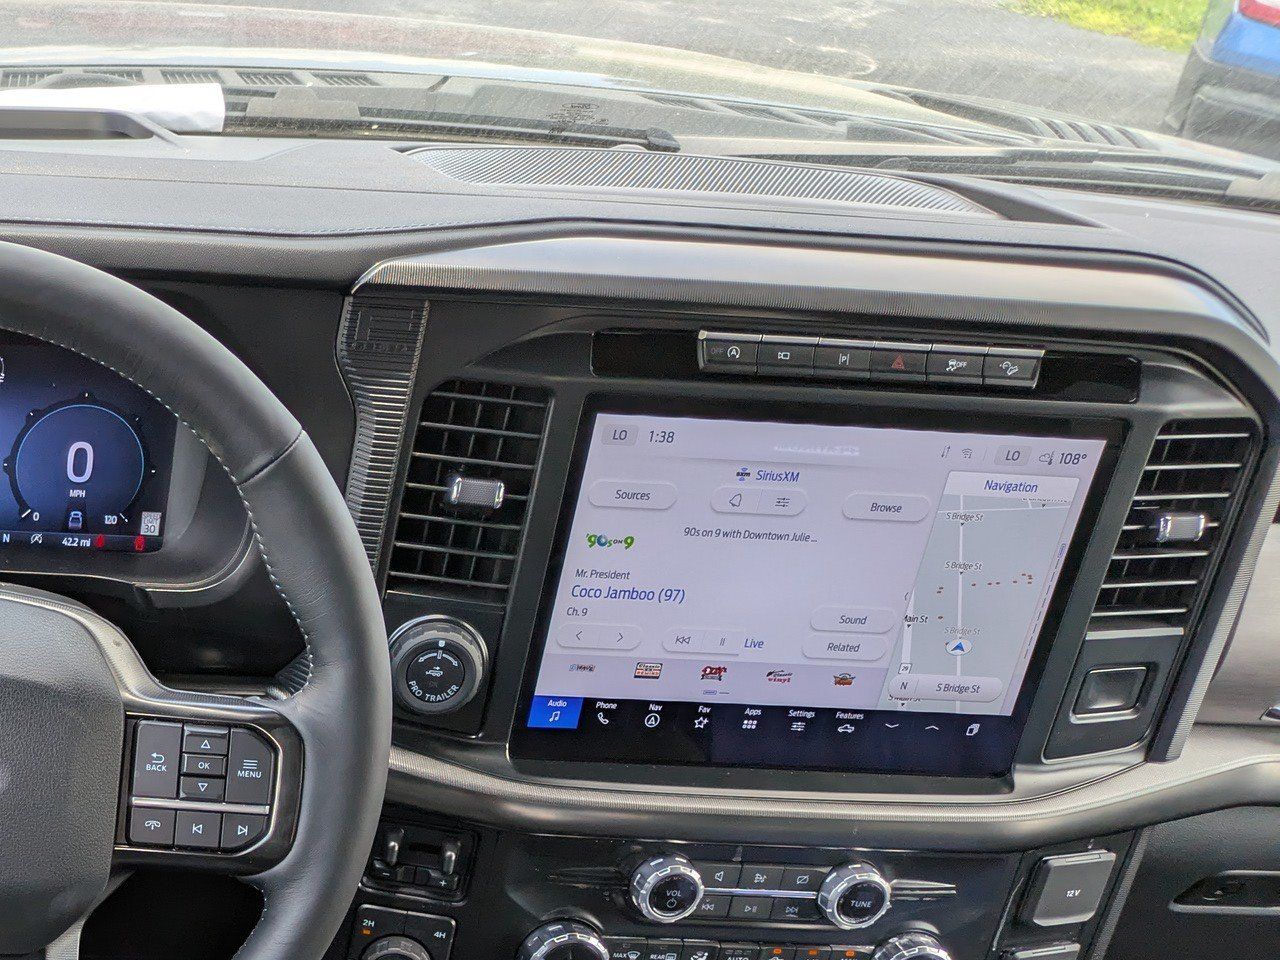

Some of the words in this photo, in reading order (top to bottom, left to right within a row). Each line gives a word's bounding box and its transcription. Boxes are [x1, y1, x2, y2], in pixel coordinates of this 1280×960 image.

[956, 360, 968, 368] OFF
[612, 429, 628, 441] LO
[648, 430, 675, 444] 1:38
[1005, 450, 1020, 462] LO
[1059, 452, 1087, 465] 108°
[66, 441, 94, 484] 0
[756, 469, 800, 482] SiriusXM
[984, 479, 1038, 493] Navigation
[70, 489, 86, 498] MPH
[614, 489, 651, 501] Sources
[870, 502, 902, 513] Browse
[32, 512, 40, 521] 0
[104, 515, 118, 525] 120
[952, 512, 974, 523] Bridge
[975, 513, 984, 522] St
[144, 524, 156, 534] 30
[3, 533, 10, 543] N
[683, 527, 701, 538] 90s
[701, 530, 713, 538] on
[722, 529, 741, 539] with
[742, 530, 790, 542] Downtown
[80, 538, 91, 547] mi
[951, 561, 973, 573] Bridge
[974, 562, 983, 570] St
[575, 569, 588, 579] Mr.
[590, 569, 630, 580] President
[571, 585, 602, 599] Coco
[604, 586, 655, 601] Jamboo
[658, 588, 686, 603] (97)
[567, 607, 580, 617] Ch.
[839, 614, 867, 625] Sound
[919, 615, 929, 624] St
[950, 627, 971, 636] Bridge
[744, 638, 764, 650] Live
[827, 642, 860, 653] Related
[408, 680, 423, 697] PRO
[425, 684, 460, 702] TRAILER
[943, 683, 966, 695] Bridge
[968, 684, 980, 693] St
[548, 700, 567, 708] Audio
[596, 701, 618, 710] Phone
[649, 703, 663, 711] Nav
[698, 706, 711, 714] Fav
[745, 708, 762, 716] Apps
[788, 709, 815, 719] Settings
[835, 711, 864, 720] Features
[146, 763, 167, 772] BACK
[198, 761, 211, 770] OK
[237, 770, 262, 779] MENU
[666, 890, 682, 898] VOL
[850, 900, 872, 909] TUNE
[362, 919, 375, 928] 2H
[433, 931, 446, 939] 4H
[650, 953, 666, 960] REAR
